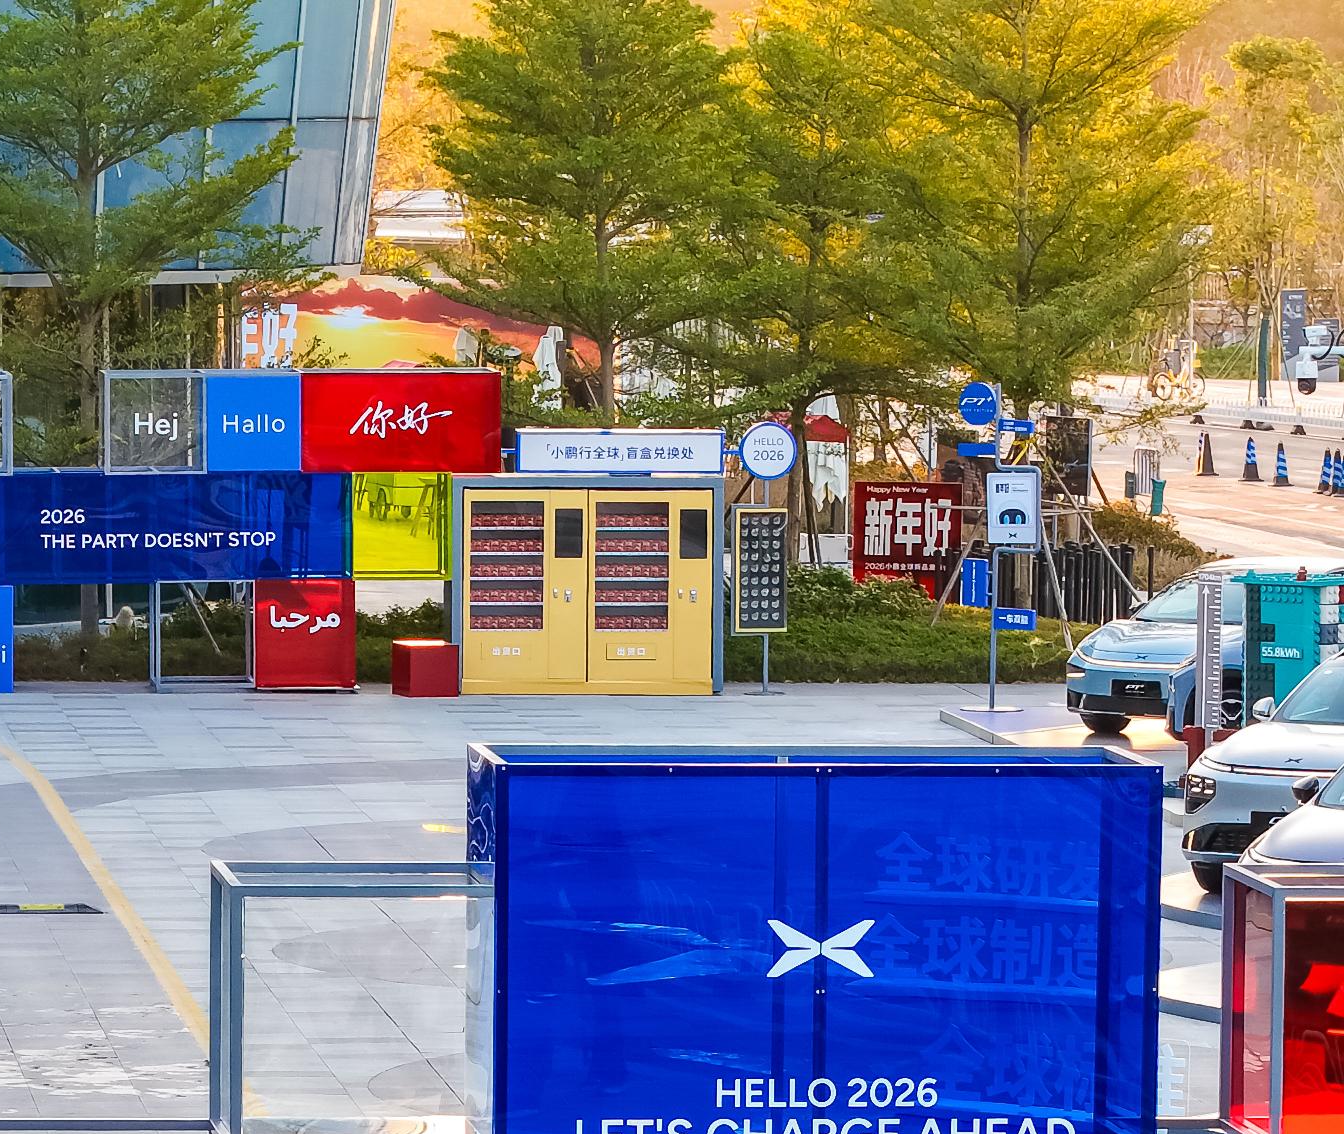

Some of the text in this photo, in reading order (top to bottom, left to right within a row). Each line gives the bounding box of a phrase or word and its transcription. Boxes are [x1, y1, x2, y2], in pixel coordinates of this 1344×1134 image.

[134, 412, 179, 441] Hej
[222, 413, 286, 434] Hallo
[349, 400, 453, 440] 你好
[753, 438, 784, 446] HELLO
[753, 450, 785, 461] 2026
[866, 485, 891, 494] Happy
[911, 486, 928, 494] Year
[40, 509, 85, 525] 2026
[864, 497, 952, 557] 新年好
[40, 531, 276, 549] THE PARTY DOESN'T STOP
[269, 605, 341, 633] مرحبا
[1261, 646, 1300, 659] 55.8kWh
[716, 1077, 938, 1108] HELLO 2026
